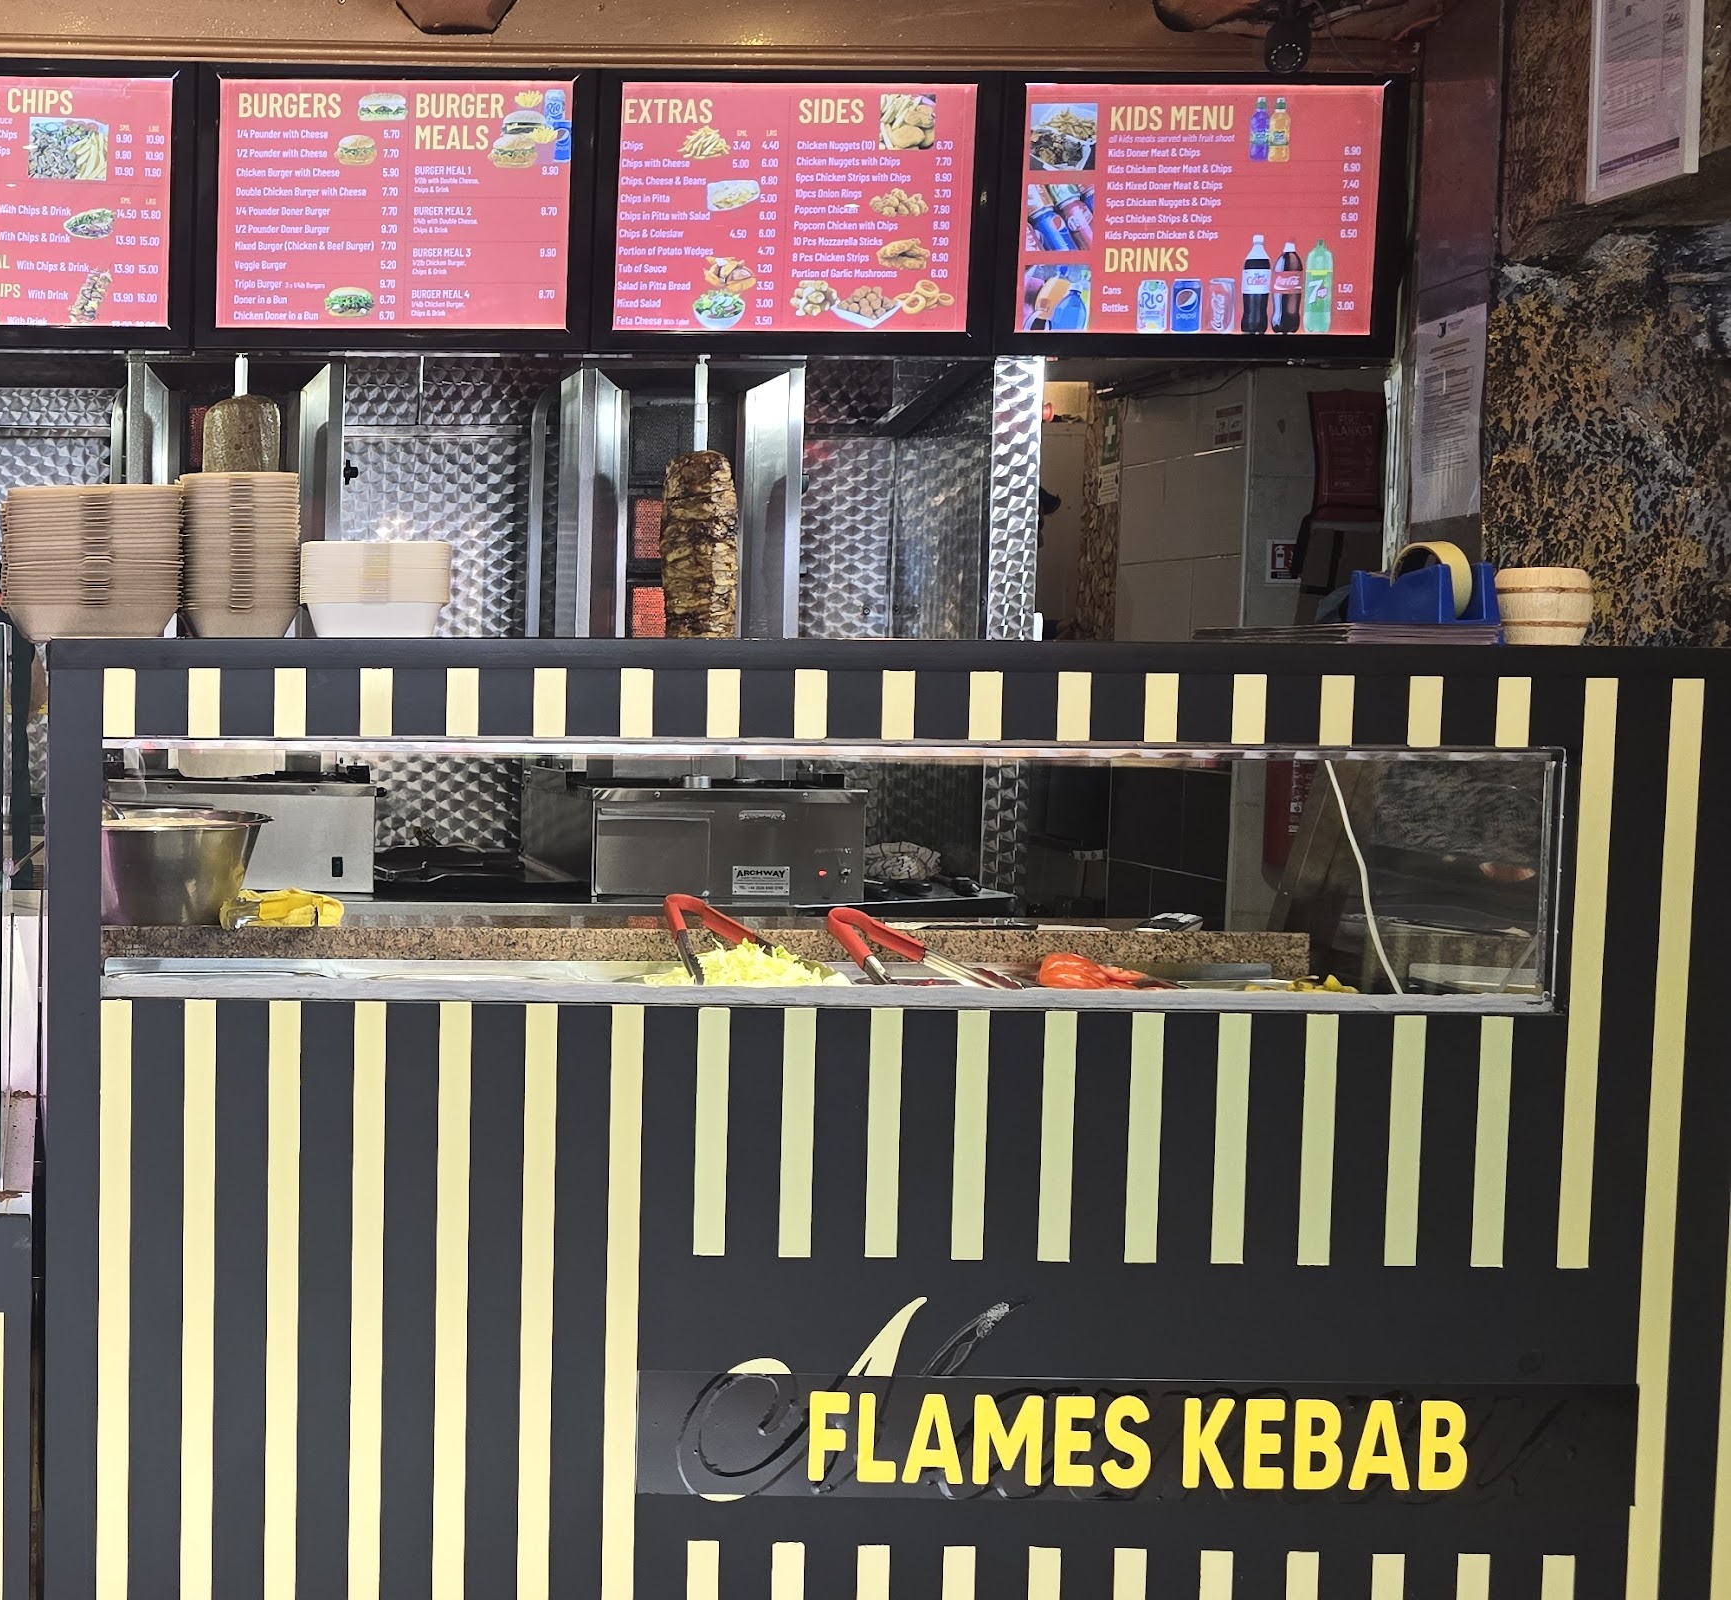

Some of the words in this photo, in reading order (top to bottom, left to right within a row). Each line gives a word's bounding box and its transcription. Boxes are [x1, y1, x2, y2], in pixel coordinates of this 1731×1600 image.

[8, 88, 72, 114] CHIPS
[238, 93, 340, 118] BURGERS
[415, 93, 504, 118] BURGER
[624, 99, 712, 124] EXTRAS
[799, 98, 863, 123] SIDES
[1110, 106, 1162, 130] KIDS
[1170, 105, 1233, 130] MENU
[250, 129, 281, 138] Pounder
[282, 129, 299, 138] with
[300, 129, 328, 138] Cheese
[415, 125, 488, 149] MEALS
[1108, 149, 1125, 157] Kids
[1126, 148, 1149, 157] Doner
[1150, 148, 1169, 157] Meat
[1170, 148, 1176, 156] &
[1179, 148, 1200, 158] Chips
[796, 156, 826, 165] Chicken
[828, 157, 859, 168] Nuggets
[861, 156, 877, 165] with
[879, 156, 900, 167] Chips
[414, 166, 444, 175] BURGER
[446, 166, 466, 175] MEAL
[468, 166, 470, 174] 1
[796, 172, 814, 183] 6pcs
[816, 172, 846, 181] Chicken
[847, 172, 870, 183] Strips
[871, 172, 888, 181] with
[890, 173, 910, 183] Chips
[18, 205, 40, 216] Chips
[41, 206, 48, 215] &
[50, 206, 72, 216] Drink
[414, 206, 443, 215] BURGER
[444, 206, 464, 215] MEAL
[466, 206, 471, 215] 2
[17, 231, 39, 243] Chips
[40, 232, 47, 242] &
[49, 232, 72, 242] Drink
[1105, 247, 1188, 272] DRINKS
[1102, 285, 1121, 294] Cans
[1102, 303, 1128, 312] Bottles
[1176, 313, 1196, 321] pepsi
[736, 870, 786, 878] ARCHWAY
[808, 1391, 1150, 1489] FLAMES
[1182, 1398, 1467, 1490] KEBAB
